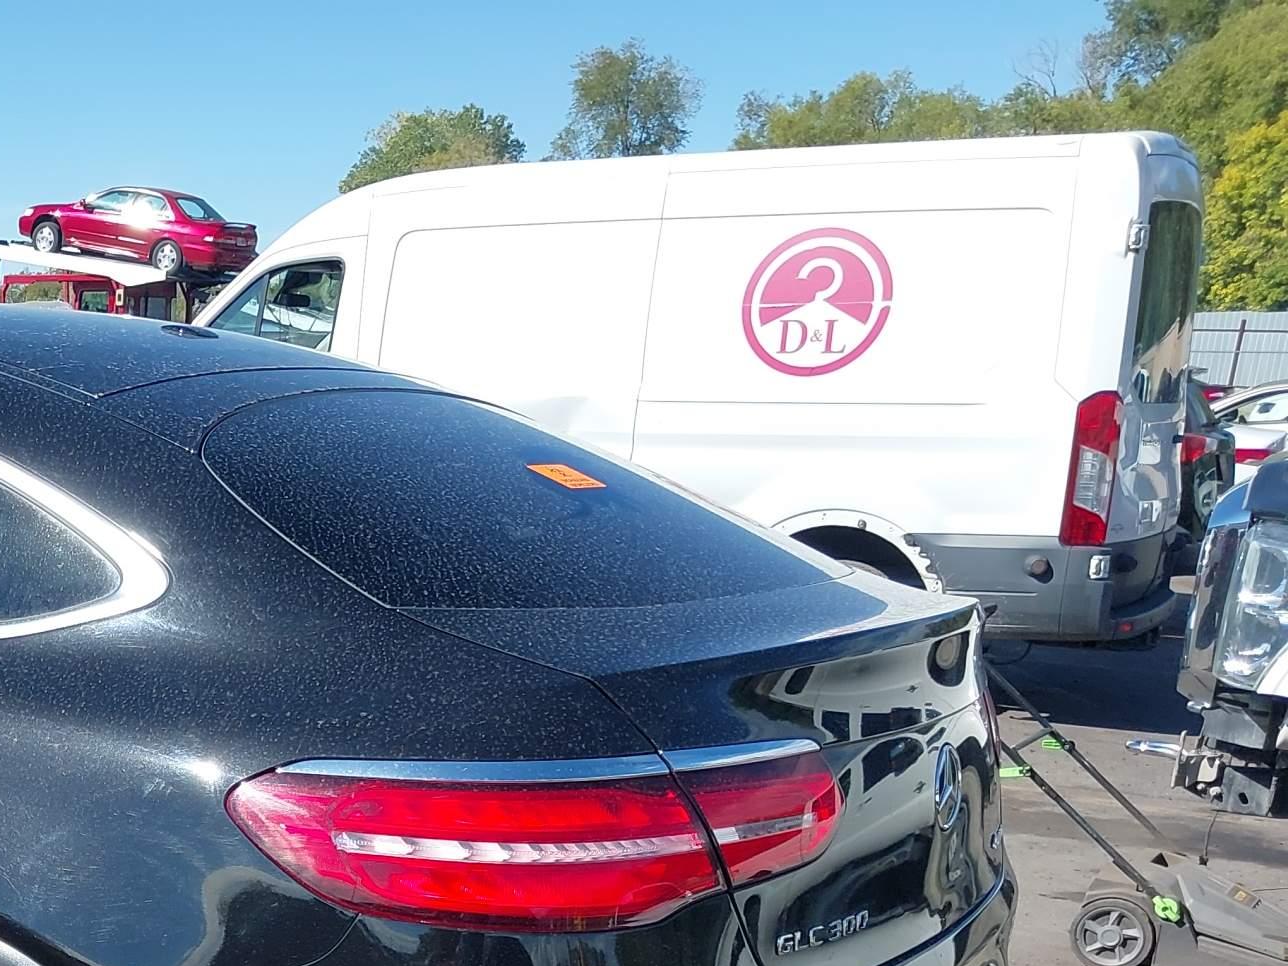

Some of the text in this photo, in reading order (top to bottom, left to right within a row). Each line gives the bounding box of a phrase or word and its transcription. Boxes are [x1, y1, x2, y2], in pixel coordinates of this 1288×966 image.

[776, 319, 846, 354] D&L
[776, 910, 869, 956] GLC 300
